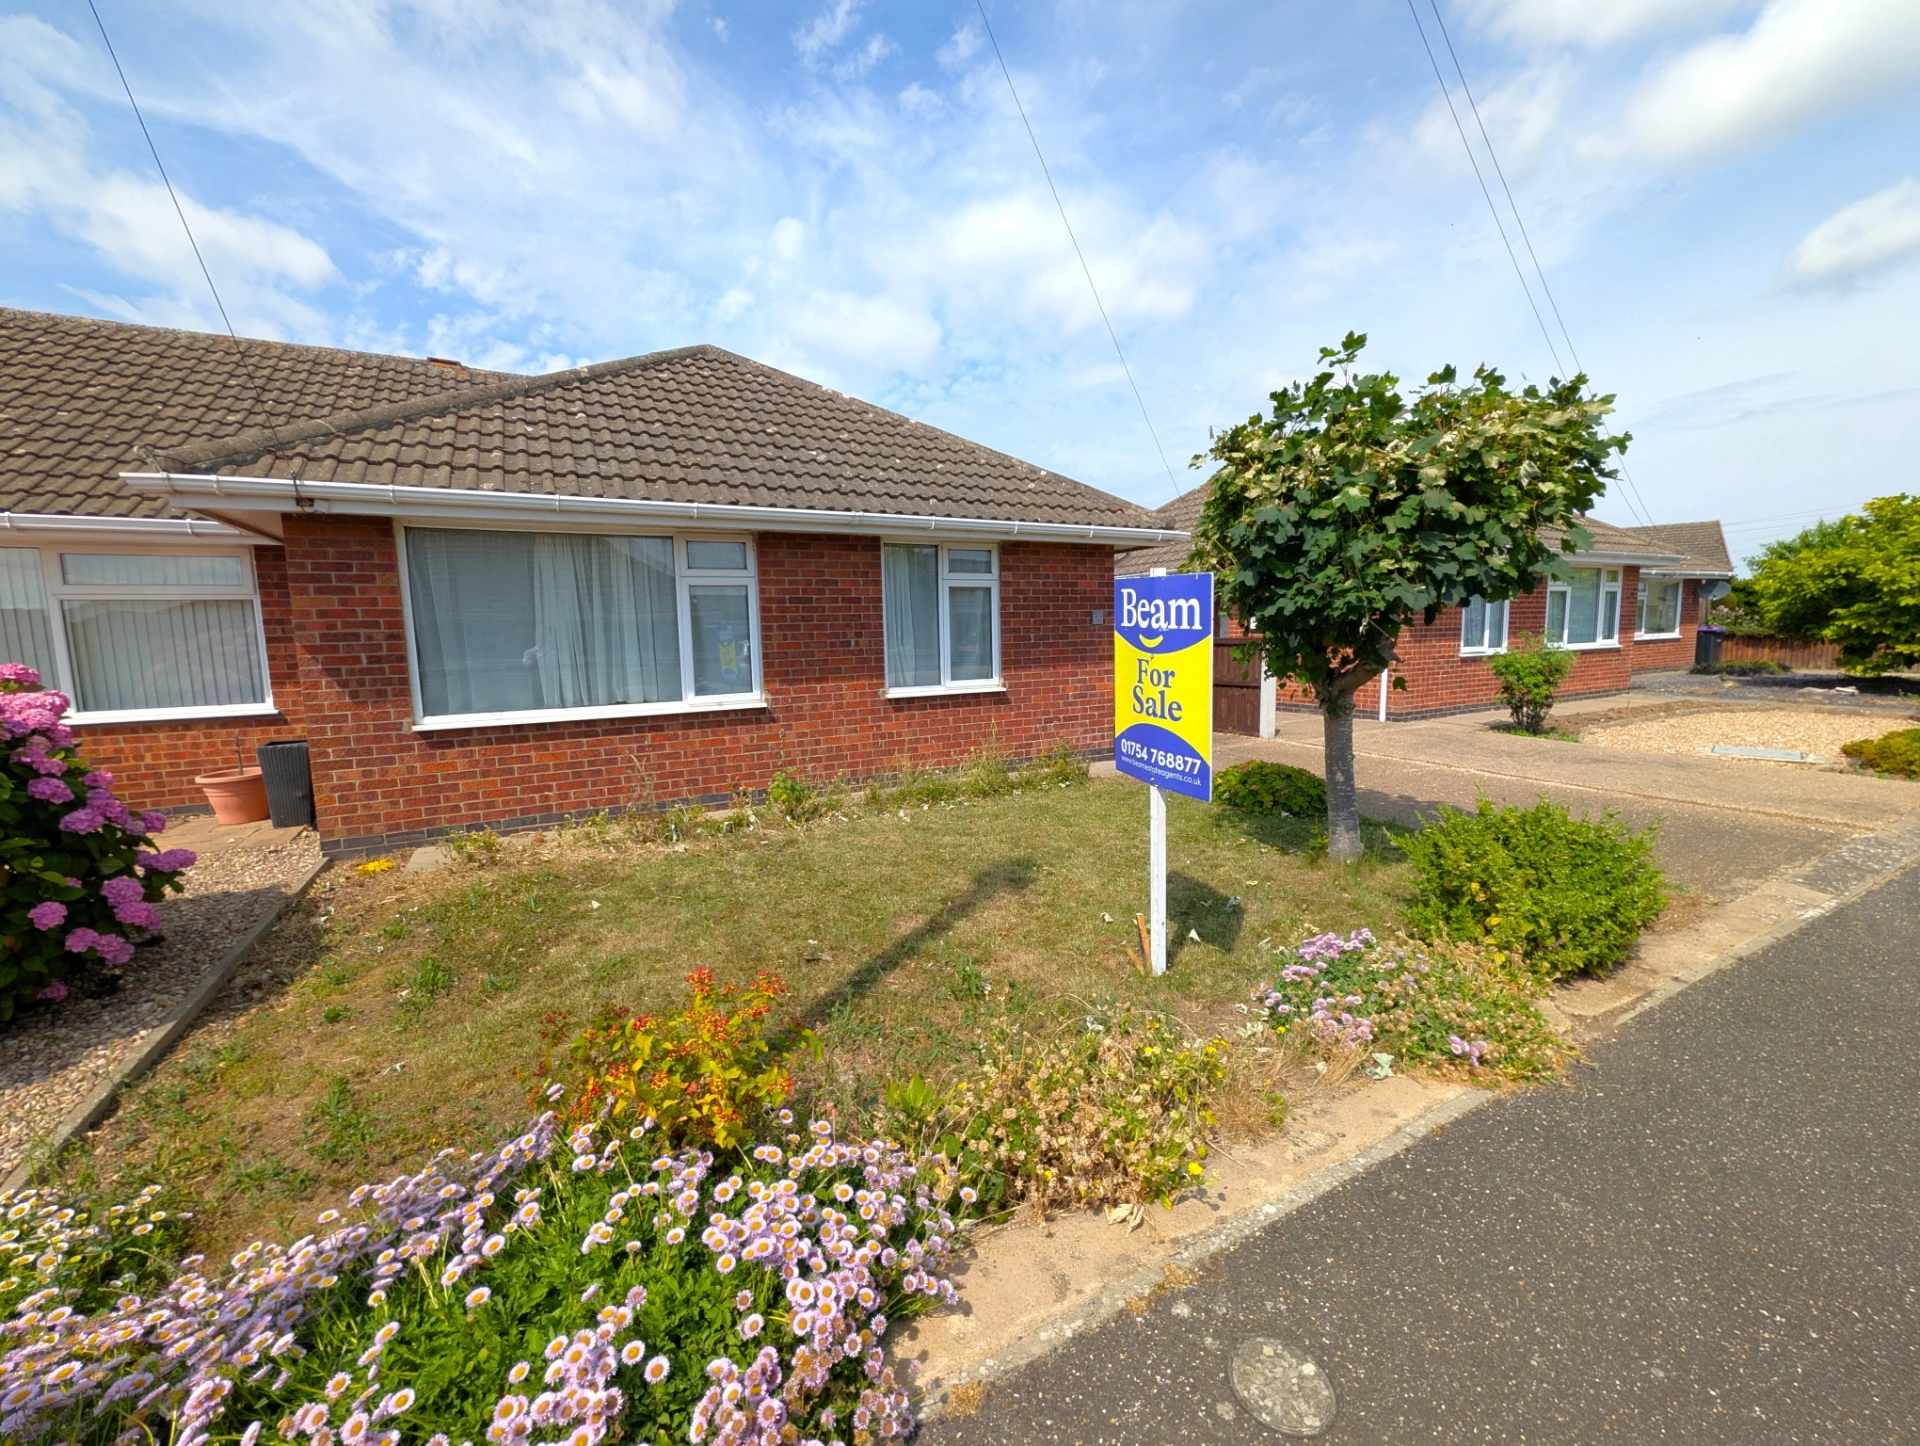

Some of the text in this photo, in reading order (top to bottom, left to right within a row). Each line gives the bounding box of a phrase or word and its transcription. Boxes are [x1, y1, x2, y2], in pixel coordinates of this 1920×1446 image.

[1121, 588, 1202, 630] Beam
[1137, 658, 1175, 688] For
[1132, 685, 1182, 721] Sale
[1121, 738, 1202, 775] 01754 768877
[1121, 755, 1202, 786] www.beamestateagents.co.uk
